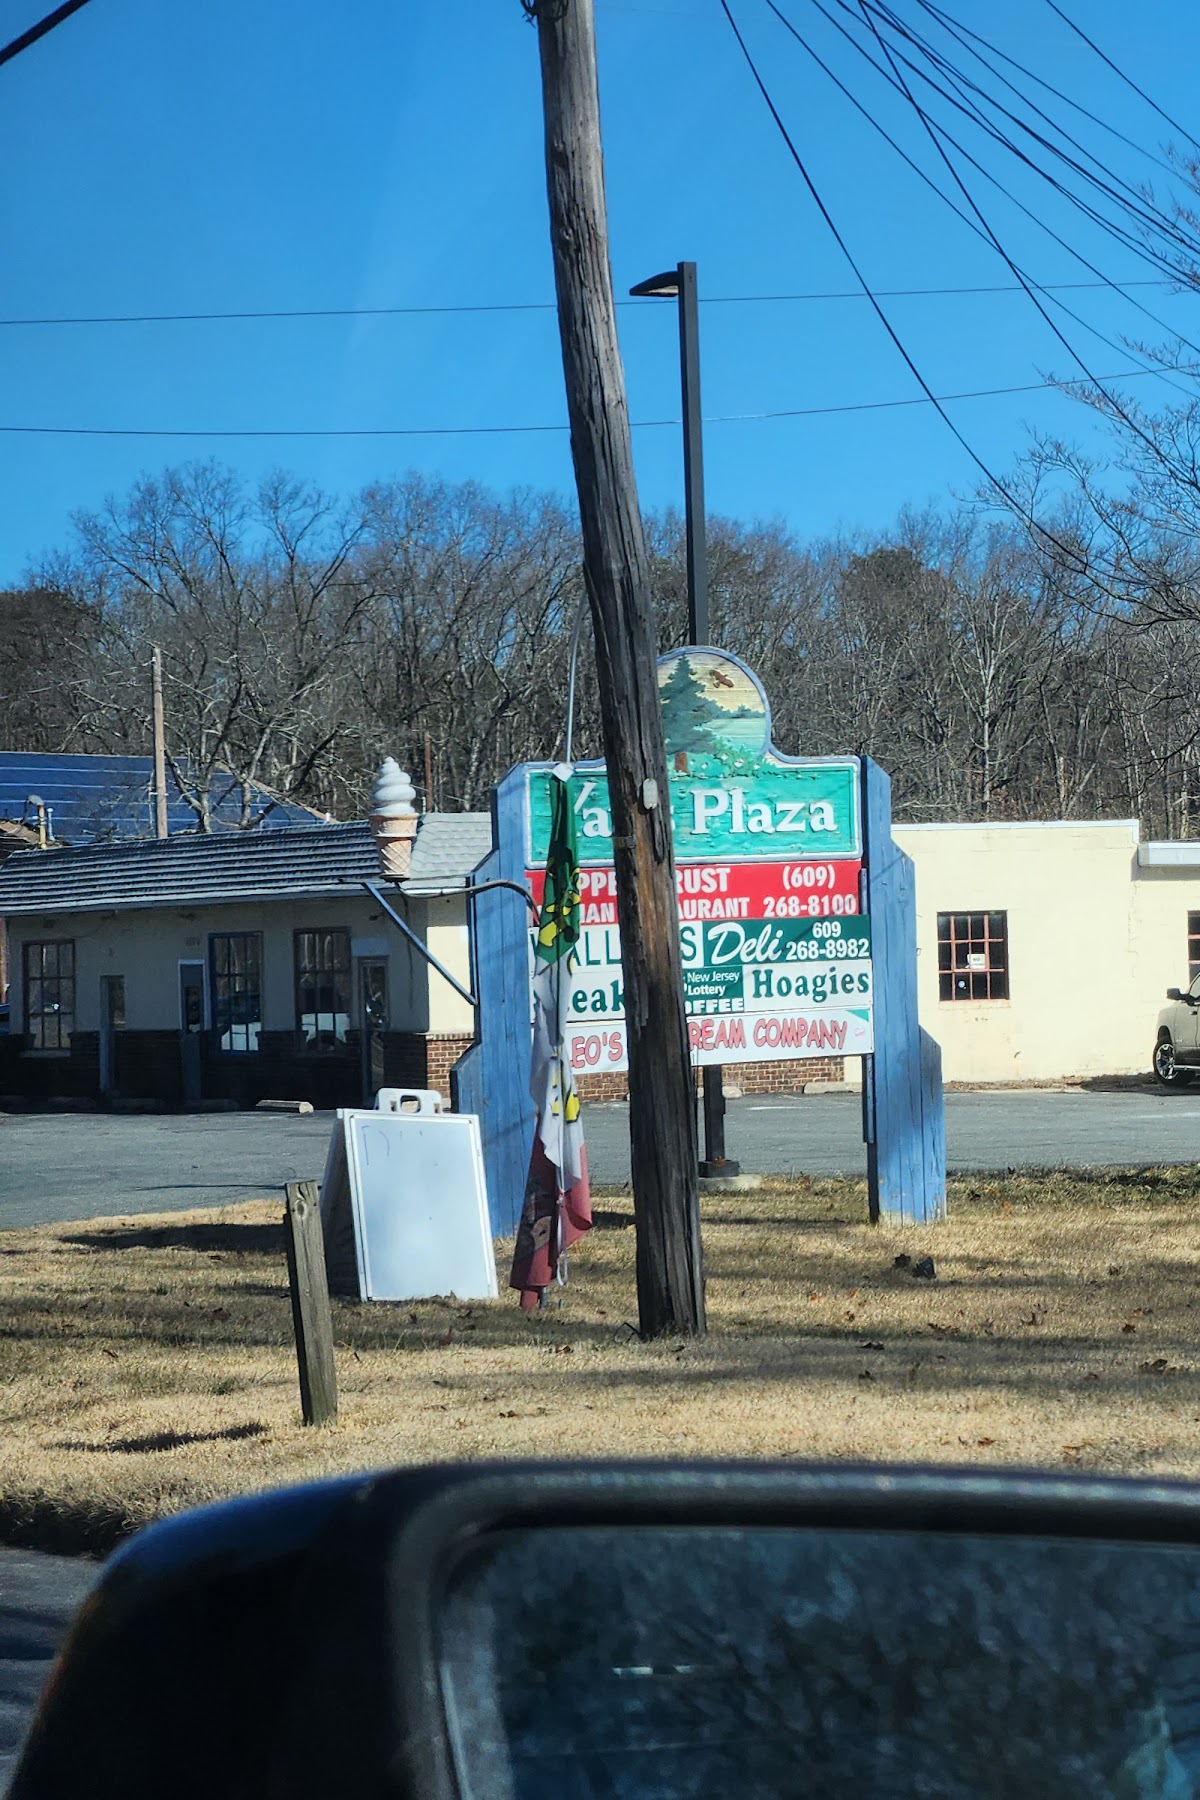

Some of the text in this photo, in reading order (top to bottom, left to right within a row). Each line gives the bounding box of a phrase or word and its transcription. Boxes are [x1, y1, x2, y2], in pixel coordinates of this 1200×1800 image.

[689, 787, 838, 835] Plaza
[783, 864, 836, 890] (609)
[763, 893, 858, 918] 268-8100
[812, 921, 841, 938] 609
[707, 921, 784, 965] Deli
[785, 938, 870, 961] 268-8982
[687, 970, 740, 983] New Jersey
[752, 966, 870, 1003] Hoagies
[687, 985, 726, 997] Lottery
[571, 1032, 623, 1069] EO'S
[753, 1017, 847, 1050] COMPANY
